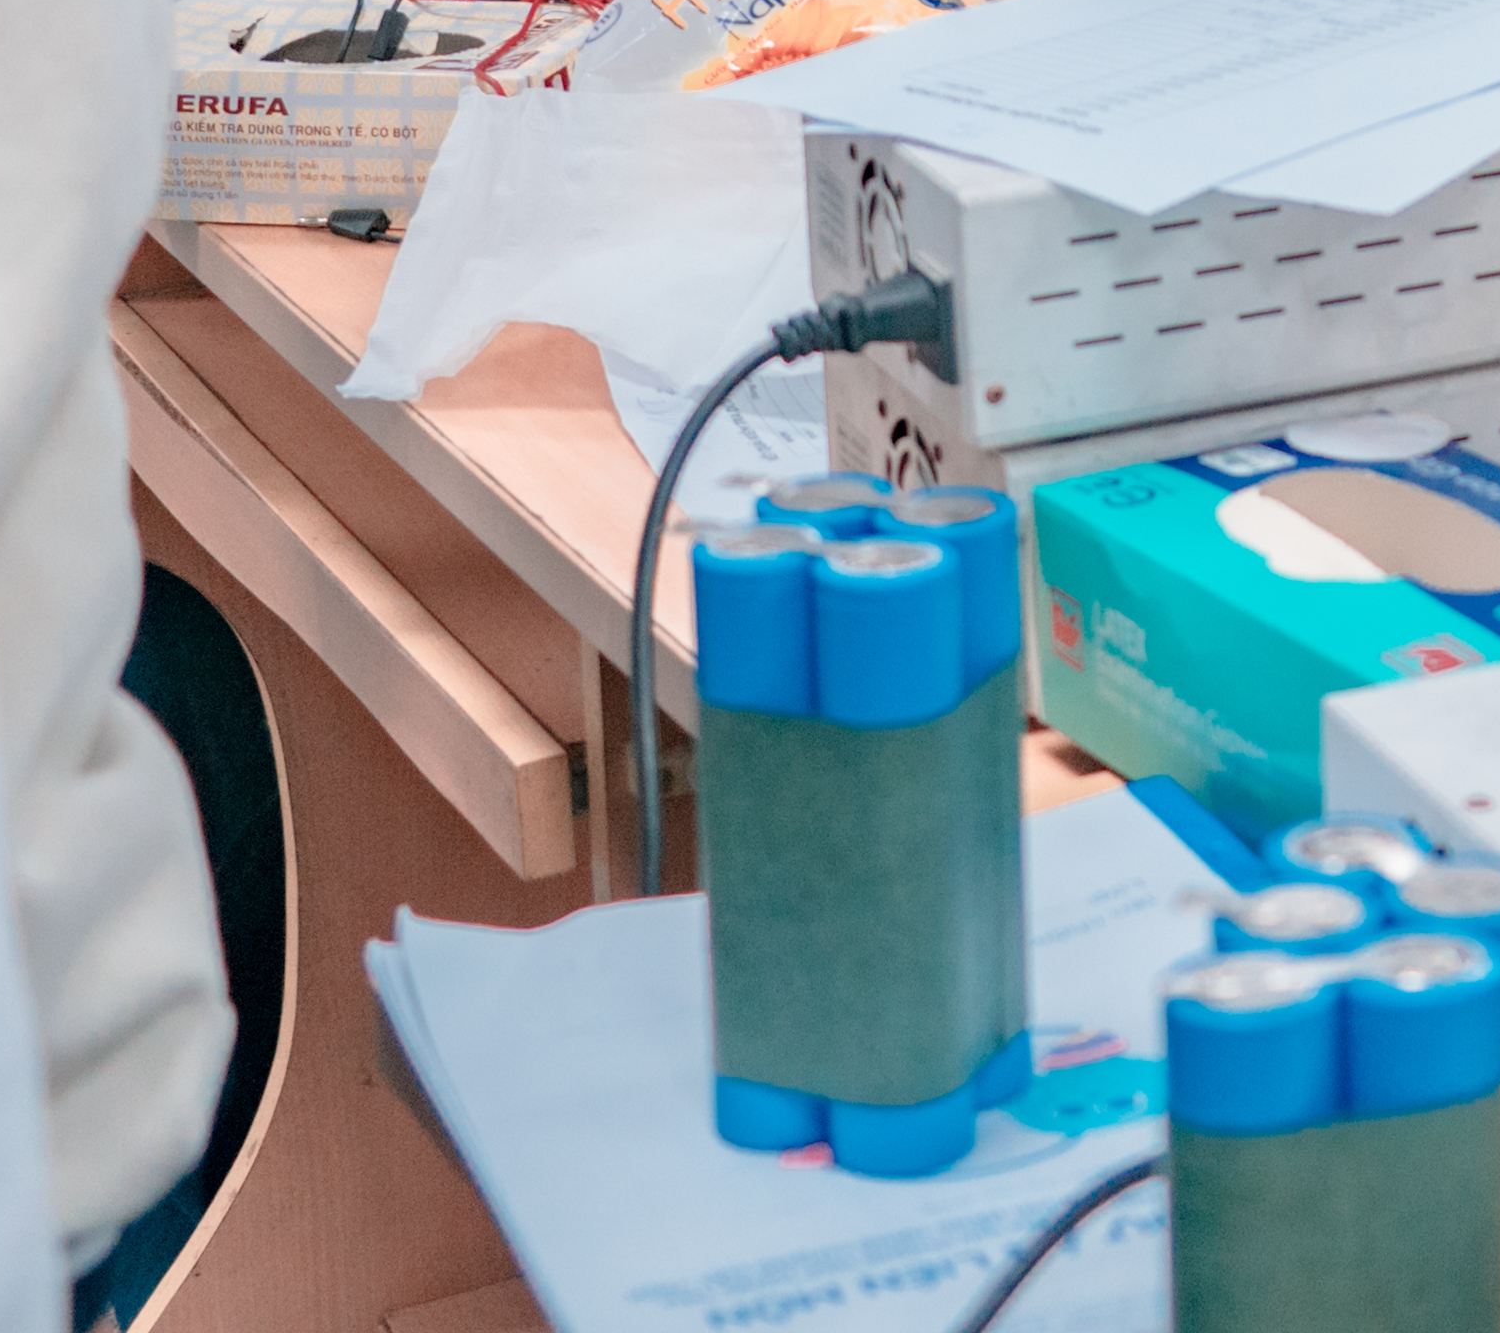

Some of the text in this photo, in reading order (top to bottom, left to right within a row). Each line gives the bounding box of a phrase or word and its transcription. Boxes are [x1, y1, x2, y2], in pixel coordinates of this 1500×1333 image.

[176, 94, 290, 116] ERUFA
[186, 117, 216, 133] KIỂM
[220, 123, 244, 134] TRA
[287, 124, 332, 137] TRONG
[336, 126, 344, 136] Y
